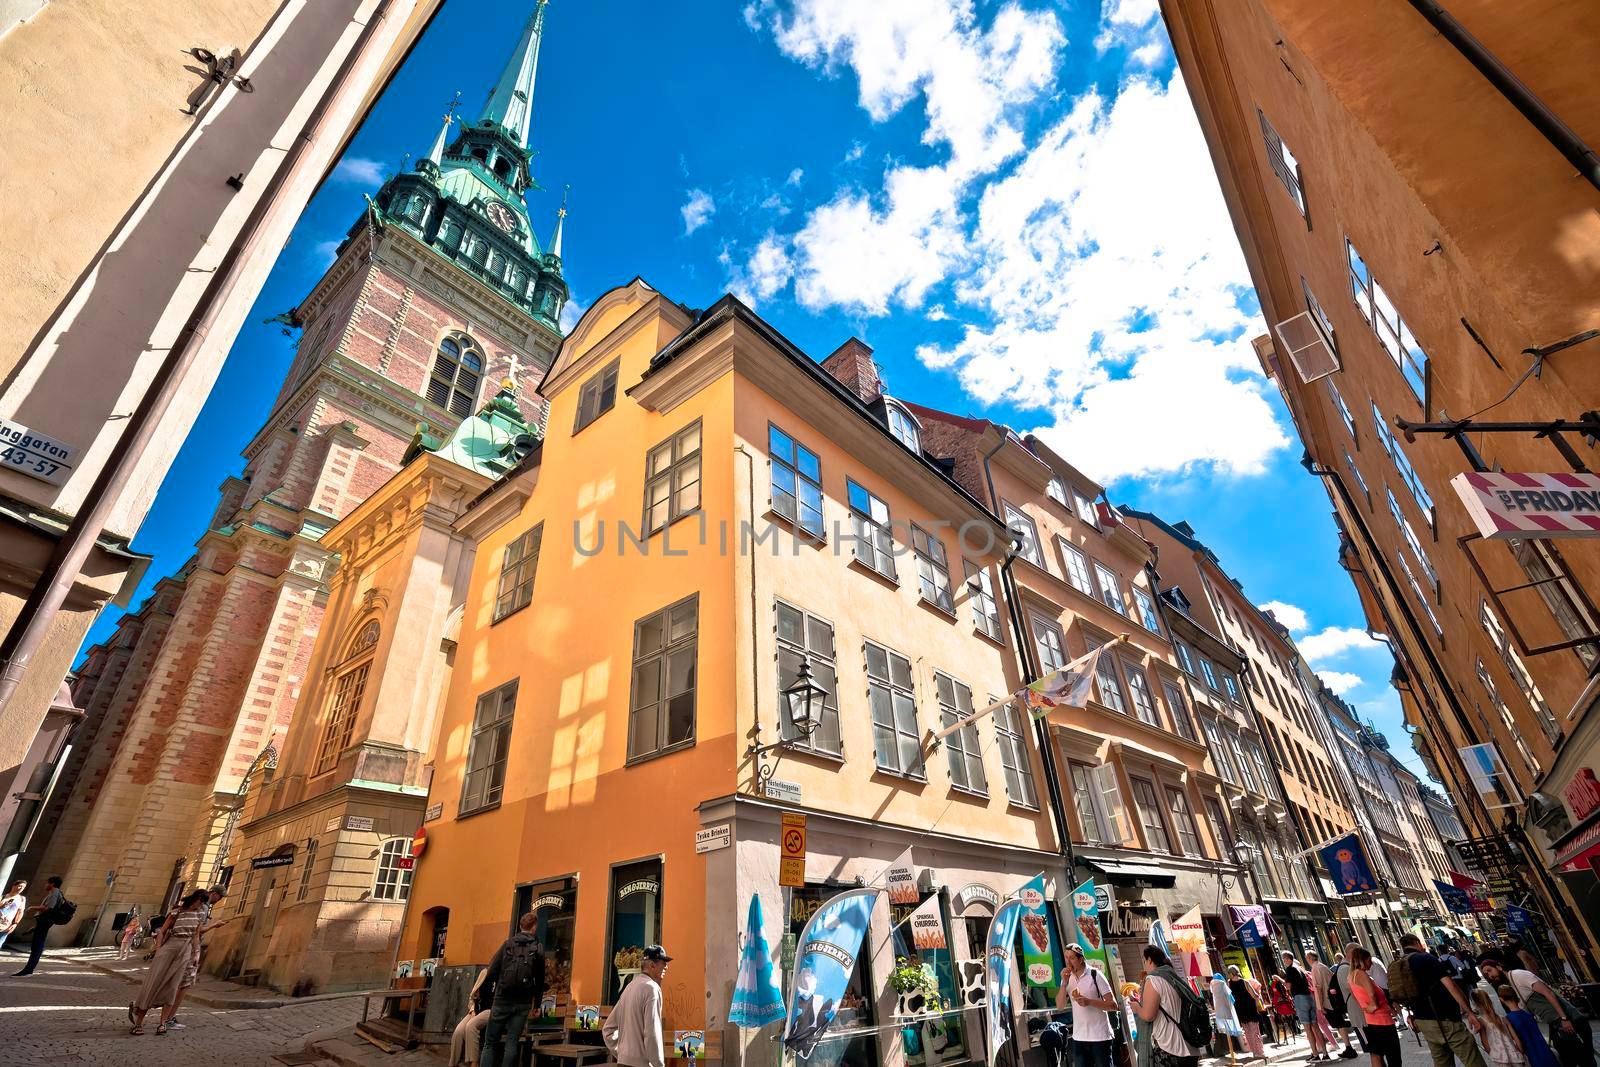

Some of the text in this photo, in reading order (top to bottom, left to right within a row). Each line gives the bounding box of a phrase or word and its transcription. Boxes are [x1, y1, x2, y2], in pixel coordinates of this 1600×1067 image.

[1, 446, 60, 477] 43-57
[1509, 490, 1600, 512] FRIDAY
[697, 827, 728, 841] Tyske Brinken
[723, 837, 729, 845] 15
[888, 873, 913, 883] CHURROS
[914, 920, 939, 928] CHURROS
